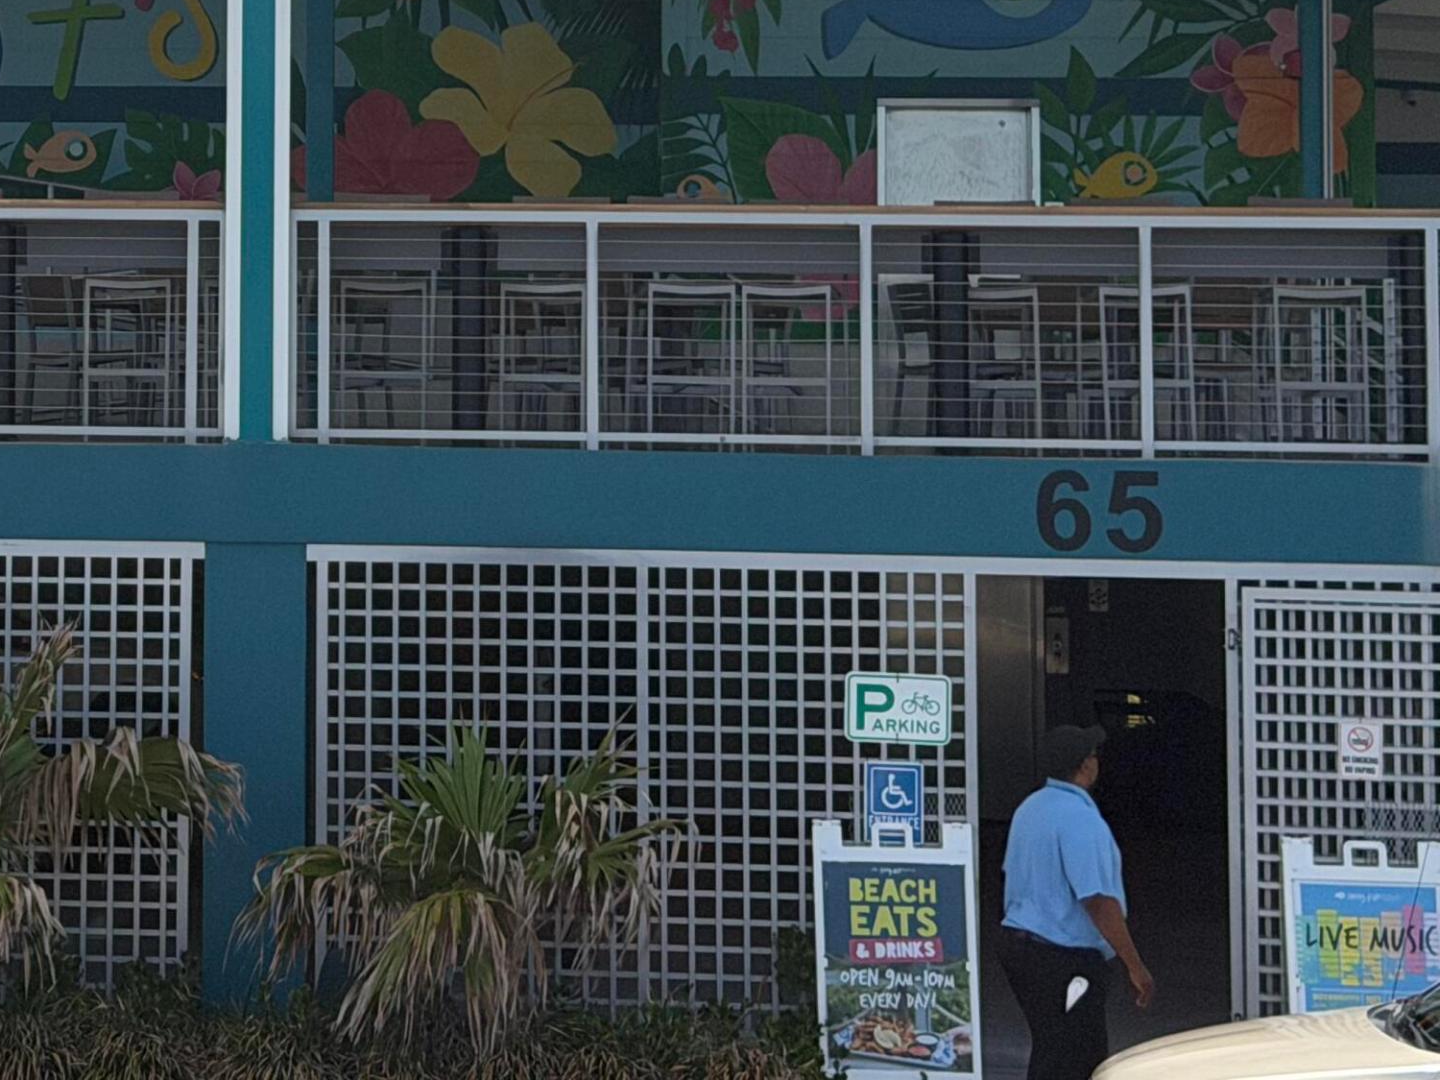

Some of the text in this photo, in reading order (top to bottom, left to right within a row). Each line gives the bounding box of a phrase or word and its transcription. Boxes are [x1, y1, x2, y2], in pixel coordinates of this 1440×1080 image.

[1036, 469, 1163, 553] 65
[848, 877, 937, 904] BEACH
[850, 905, 938, 937] EATS
[856, 941, 936, 959] & DRINKS
[1306, 922, 1437, 956] LIVE MUSIC
[840, 967, 879, 987] OPEN
[859, 991, 901, 1010] EVERY
